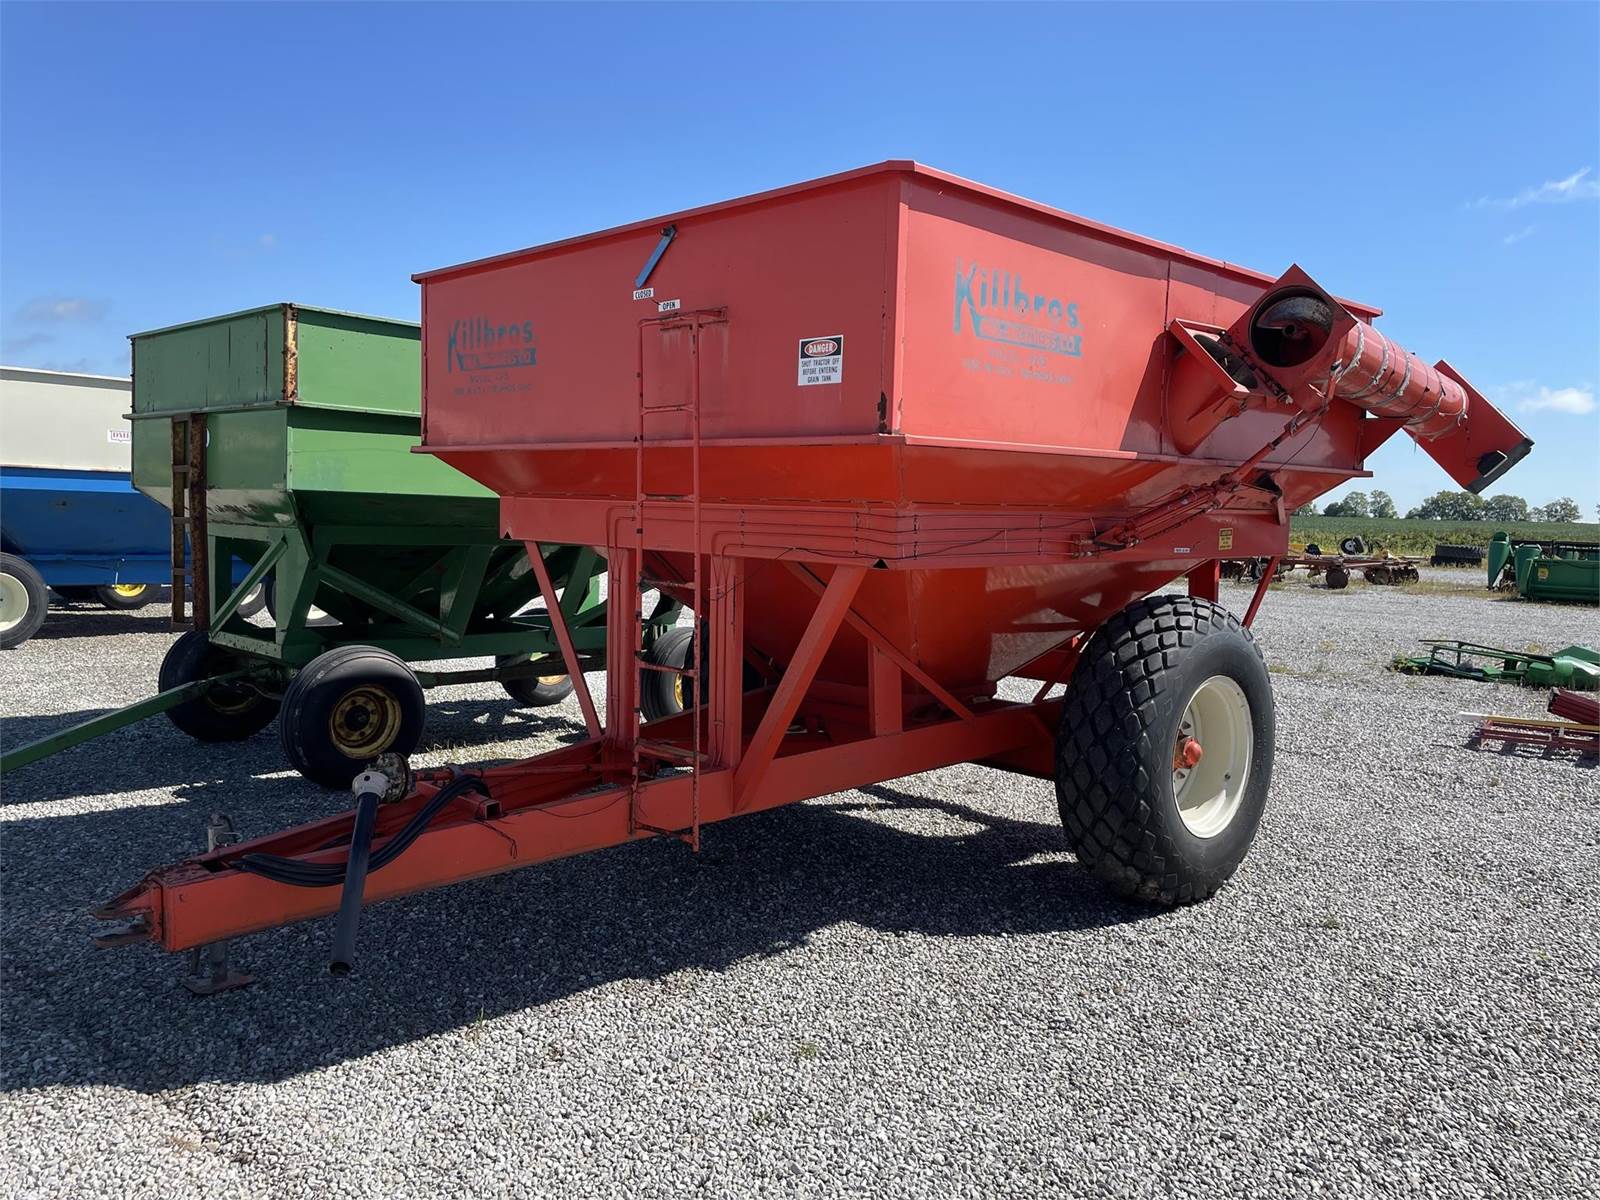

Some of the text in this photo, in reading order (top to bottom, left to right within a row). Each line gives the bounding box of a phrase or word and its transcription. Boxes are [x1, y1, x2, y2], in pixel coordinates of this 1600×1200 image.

[634, 289, 652, 299] CLOSED
[952, 257, 1080, 335] Killbros
[662, 301, 676, 310] OPEN
[808, 342, 834, 354] DANGER
[801, 357, 840, 368] SHUT TRACTOR OFF
[802, 366, 838, 376] BEFORE ENTERING
[807, 375, 832, 384] GRAIN TANK
